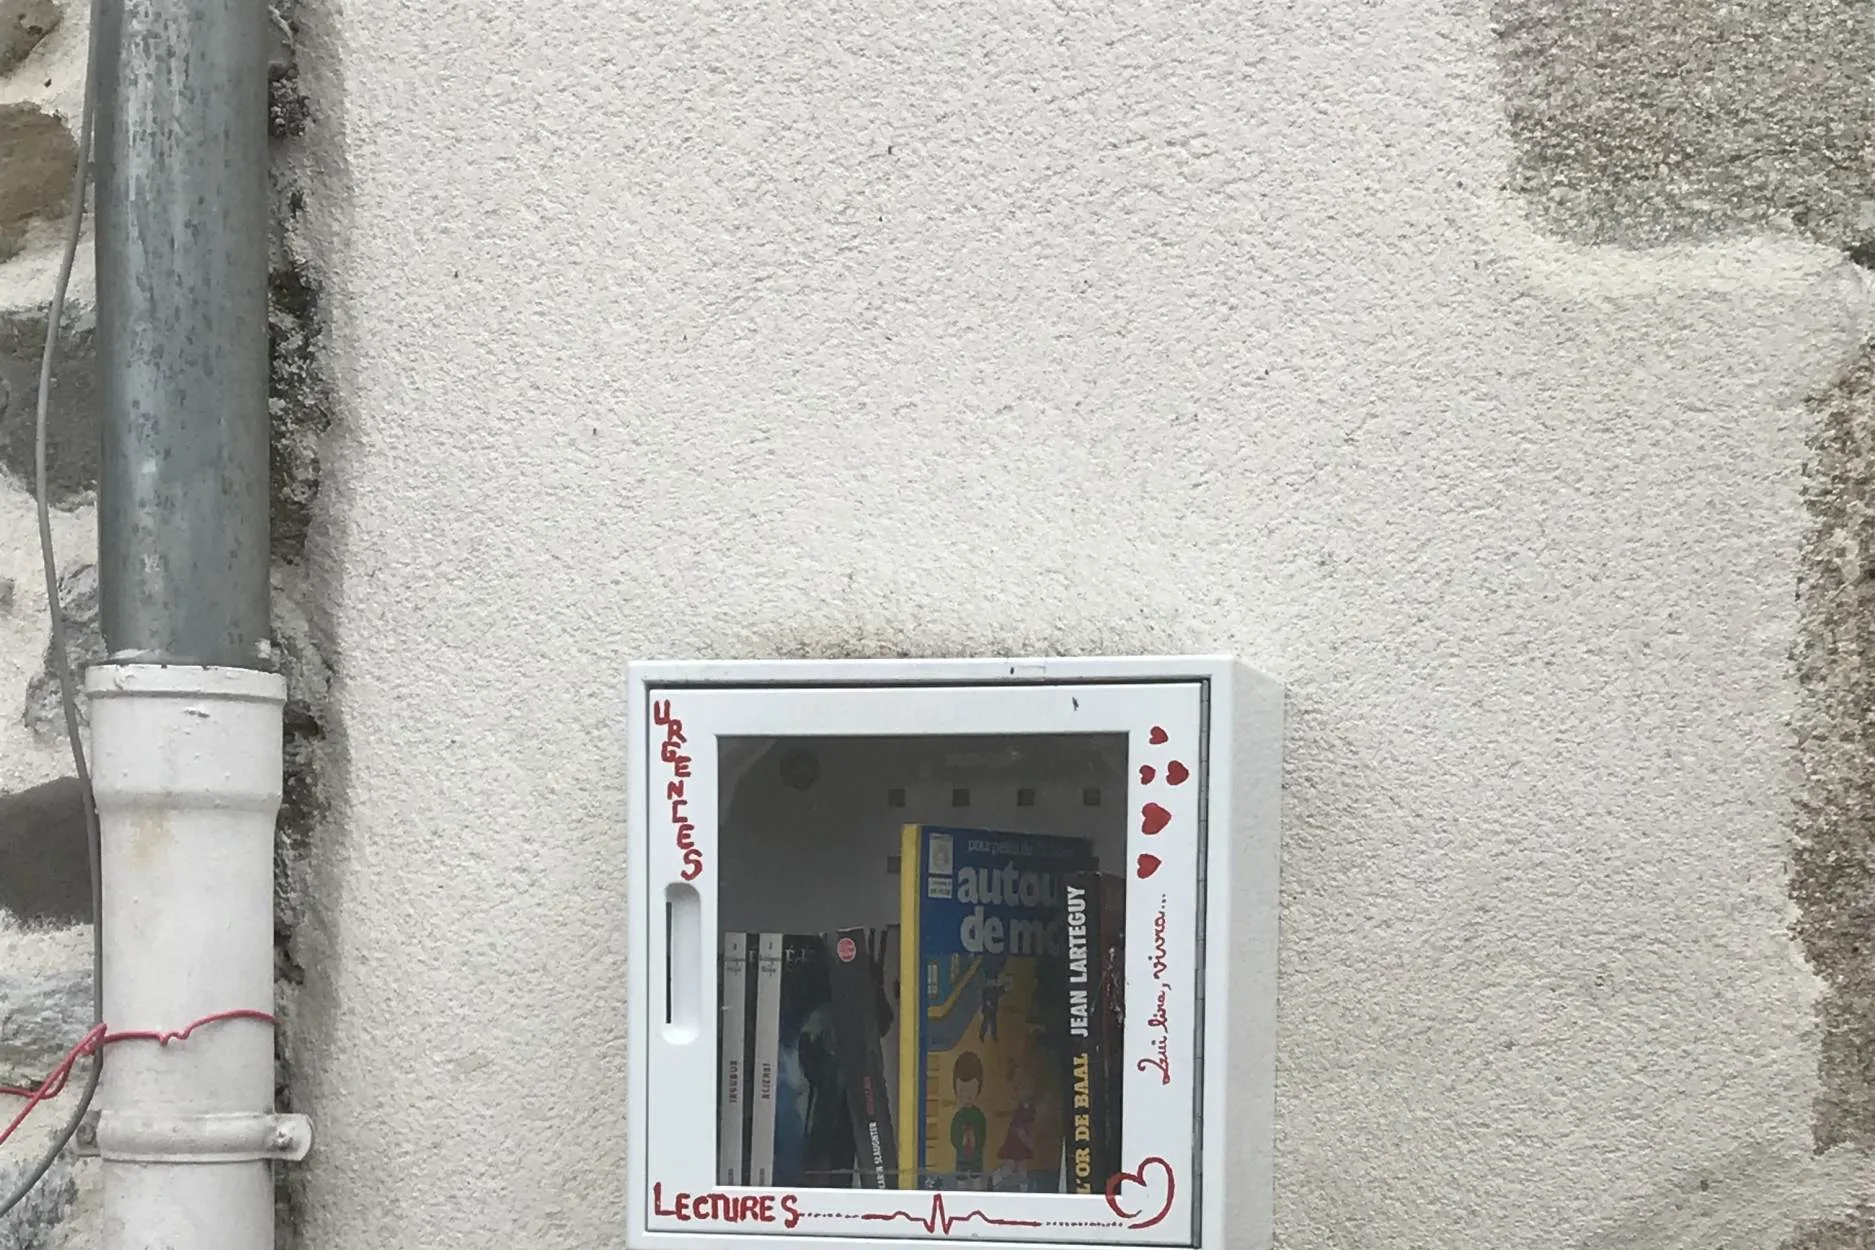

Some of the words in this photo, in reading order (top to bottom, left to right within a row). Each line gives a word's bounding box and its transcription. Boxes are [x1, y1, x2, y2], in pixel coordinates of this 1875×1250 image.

[960, 905, 1004, 954] de
[1067, 885, 1088, 983] LARTEGUY
[1069, 990, 1089, 1037] JEAN
[1073, 1053, 1090, 1108] BAAL
[1074, 1114, 1090, 1141] DE
[653, 1183, 799, 1229] LECTURES
